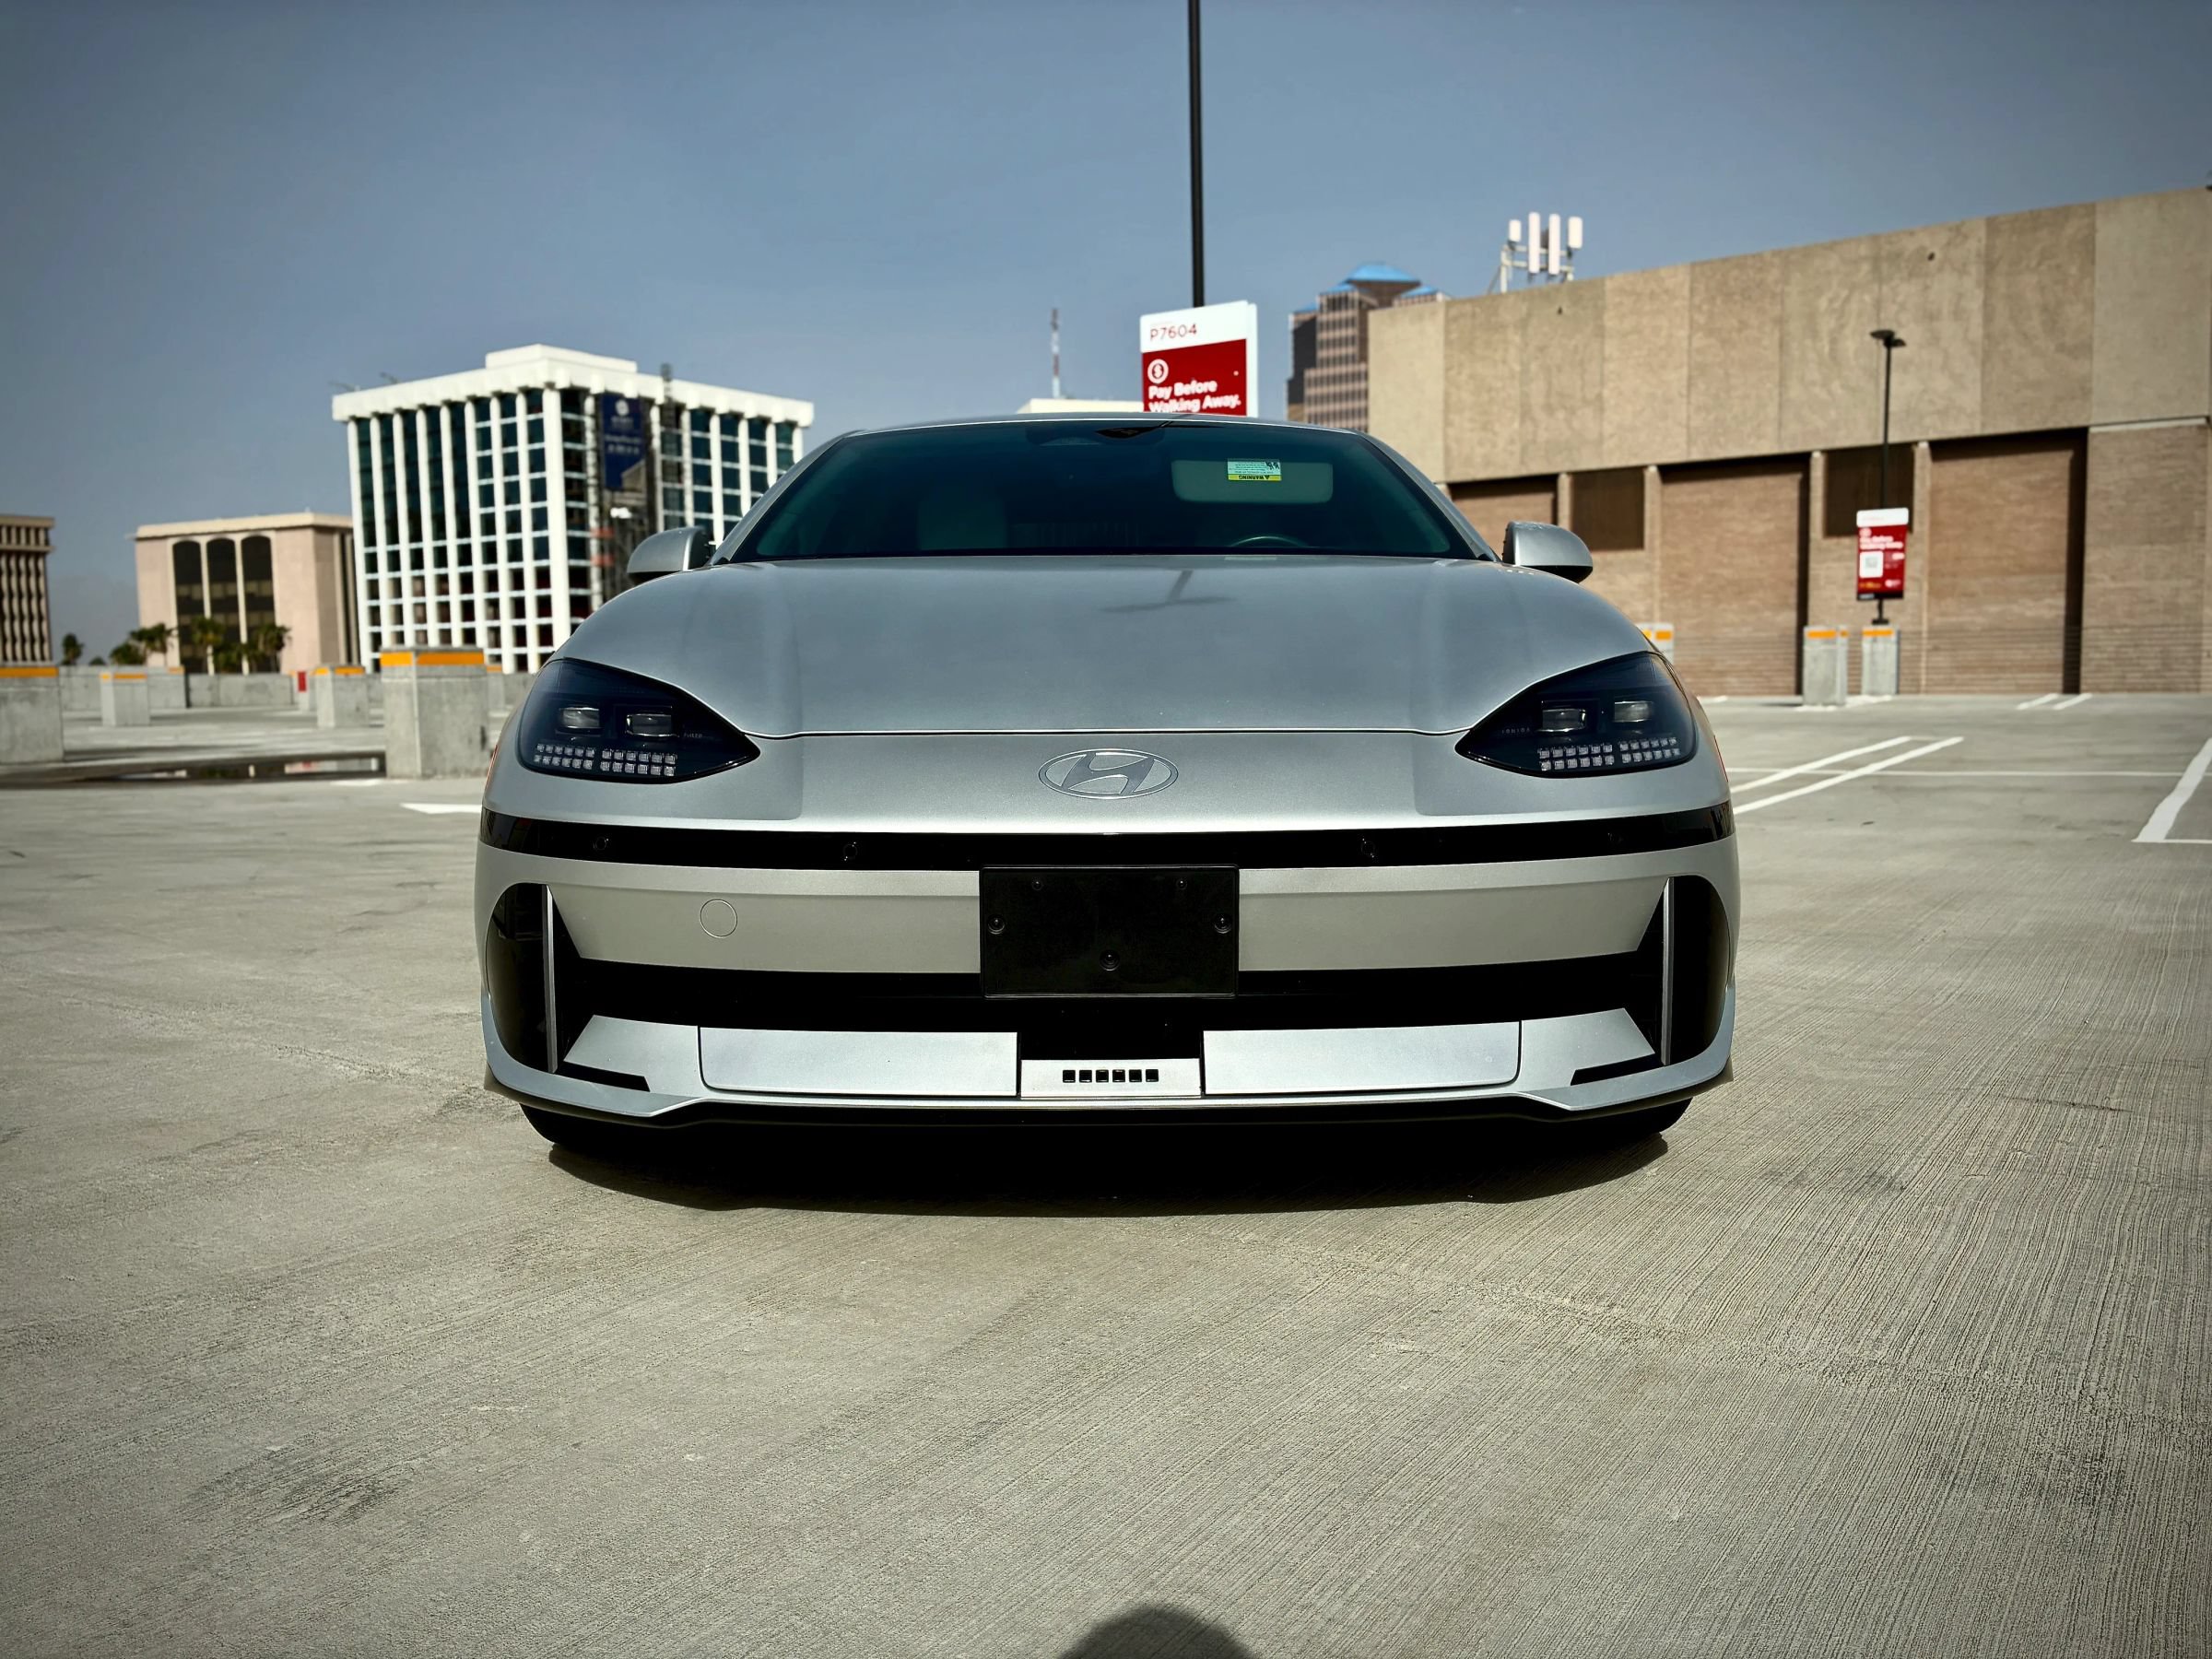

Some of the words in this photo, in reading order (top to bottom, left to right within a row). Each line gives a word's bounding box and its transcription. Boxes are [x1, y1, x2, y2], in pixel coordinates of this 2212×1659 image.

[1149, 323, 1197, 342] P7604
[1148, 385, 1172, 399] Pay
[1174, 380, 1218, 396] Before
